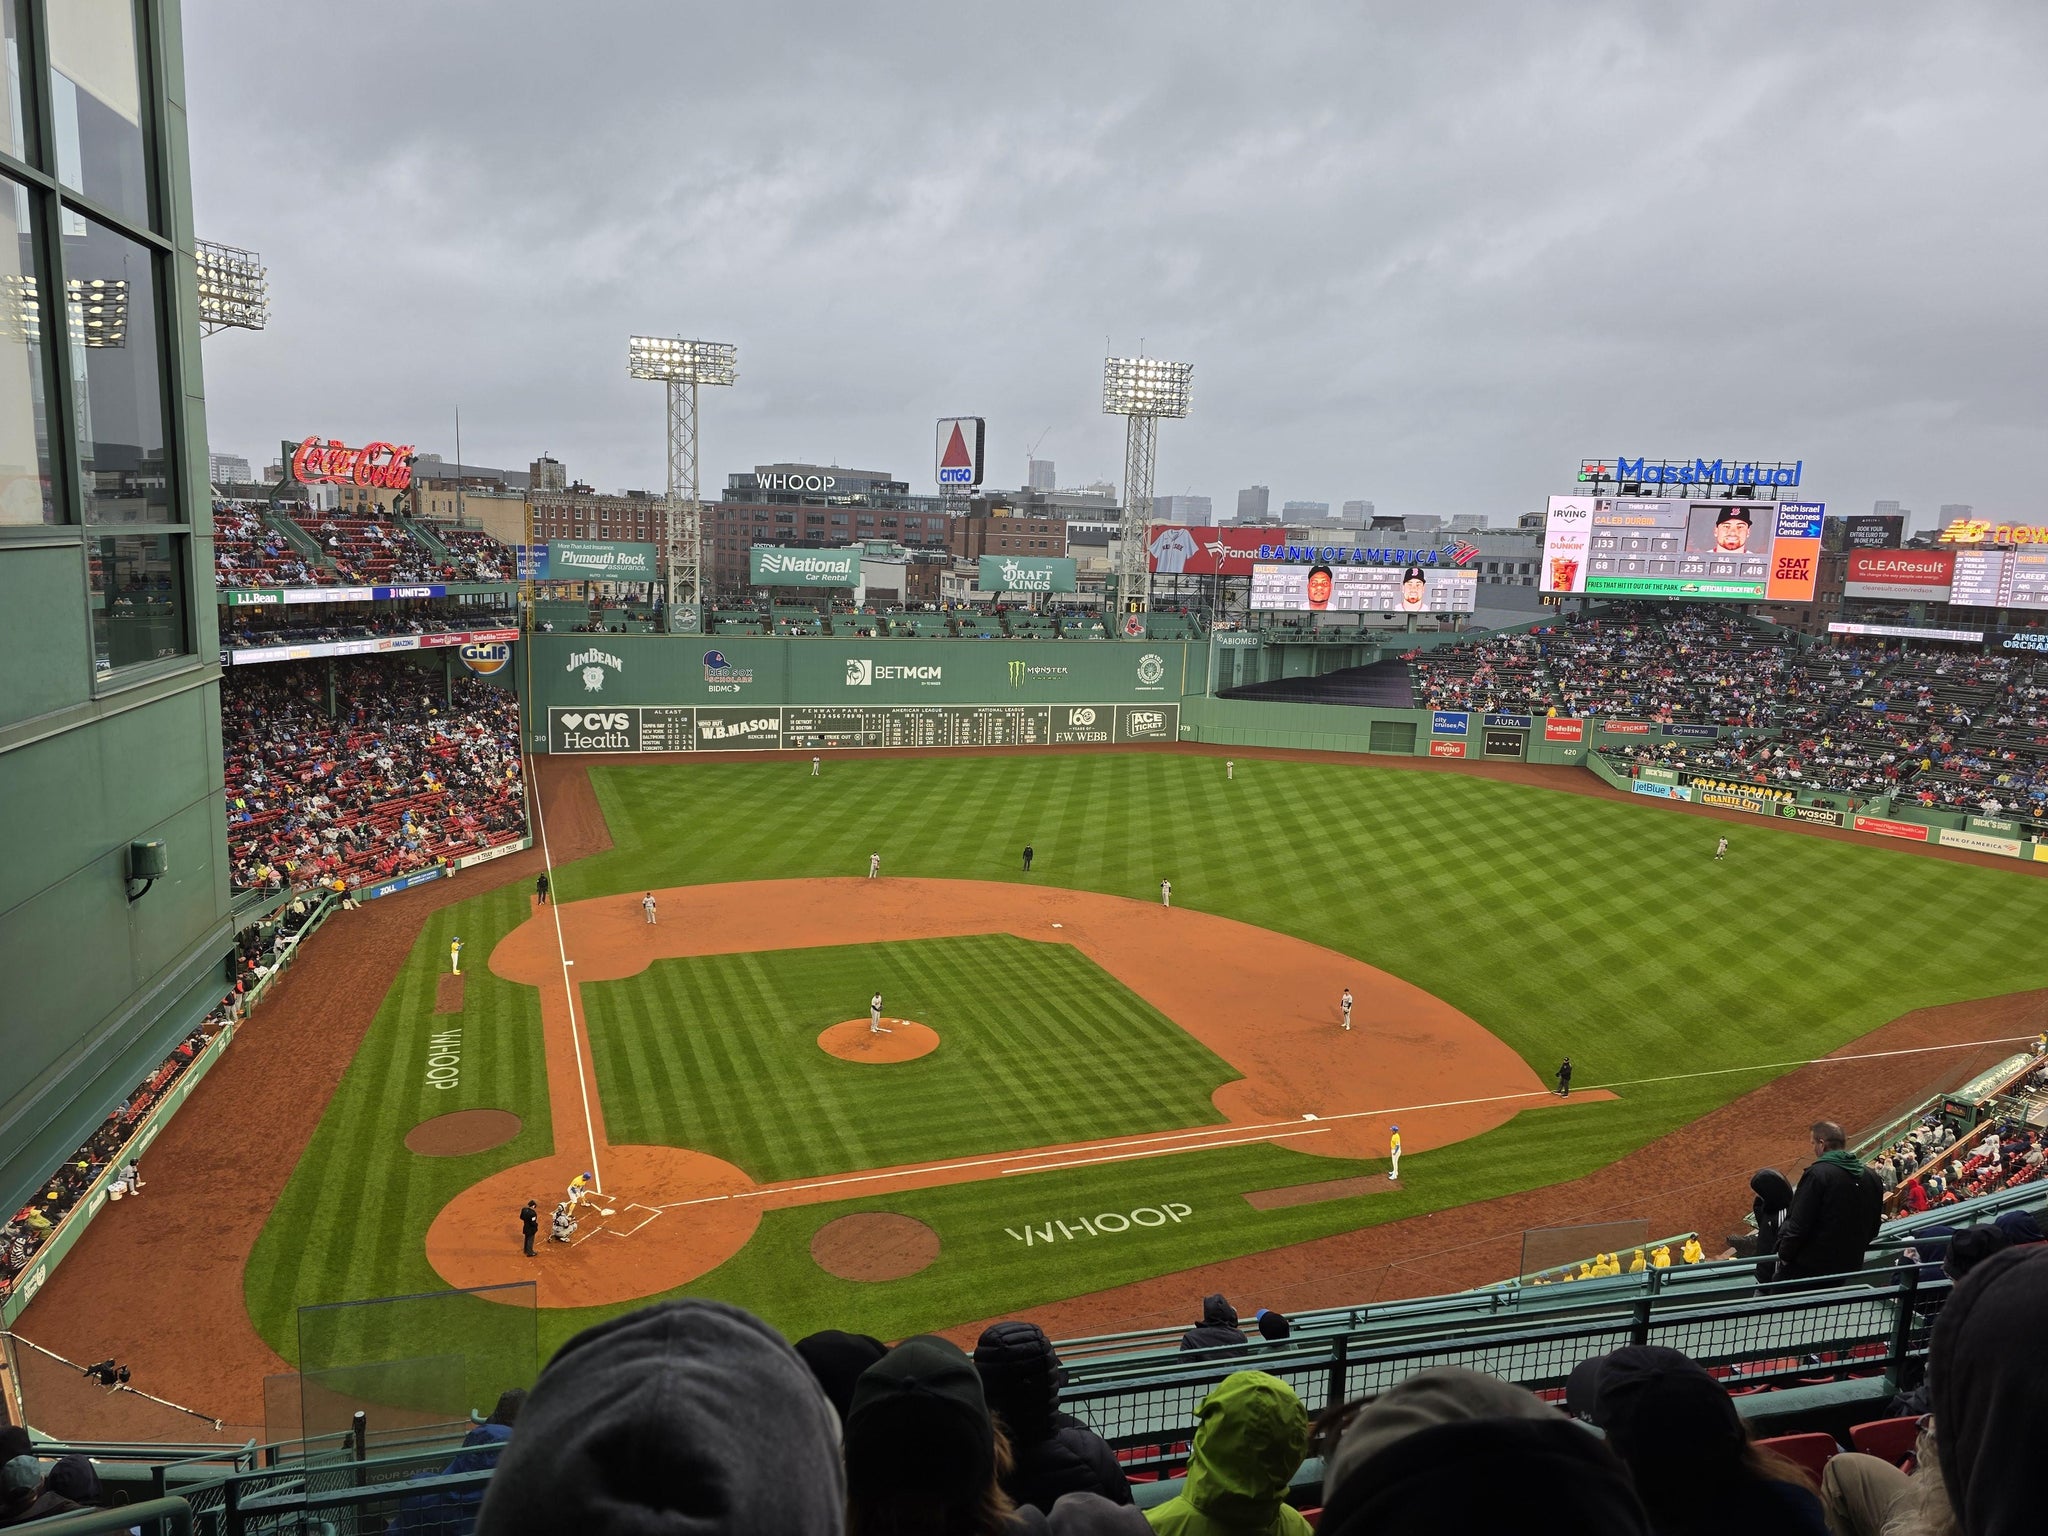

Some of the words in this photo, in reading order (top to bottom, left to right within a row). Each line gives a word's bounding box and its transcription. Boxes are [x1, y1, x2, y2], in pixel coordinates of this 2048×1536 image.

[293, 435, 415, 489] Coca-Cola
[940, 469, 971, 482] CITGO
[1615, 456, 1803, 487] MassMutual
[756, 473, 836, 492] WHOOP
[1553, 510, 1587, 518] IRVING
[1800, 505, 1820, 513] Israel
[1595, 517, 1623, 525] CALEB
[1624, 517, 1656, 525] DURBIN
[1780, 513, 1821, 521] Deaconess
[1778, 528, 1804, 536] Center
[561, 551, 614, 566] Plymouth
[617, 553, 645, 565] Rock
[1261, 545, 1316, 561] BANK
[1322, 546, 1346, 561] OF
[1352, 546, 1438, 563] AMERICA
[1779, 558, 1810, 568] SEAT
[1858, 560, 1943, 573] CLEAResult
[1680, 565, 1703, 573] .235
[1712, 566, 1733, 574] .183
[1743, 567, 1763, 575] .418
[1003, 569, 1053, 582] DRAFT
[1776, 570, 1809, 581] GEEK
[1008, 581, 1051, 590] KINGS
[1862, 585, 1933, 593] clearesult.com/redsox
[400, 588, 431, 597] UNITED
[238, 593, 277, 604] L.L.Bean
[1363, 600, 1369, 609] 2
[1383, 600, 1389, 609] 0
[1223, 637, 1258, 645] ABIOMED
[2012, 633, 2048, 642] ANGR
[462, 645, 506, 660] Gulf
[566, 653, 589, 672] JIM
[589, 648, 623, 672] BEAM
[875, 666, 942, 679] BETMGM
[1027, 666, 1068, 674] MONSTER
[583, 713, 630, 731] CVS
[1134, 712, 1163, 723] ACE
[1135, 722, 1162, 732] TICKET
[1547, 724, 1581, 733] Safelite
[564, 732, 630, 748] Health
[1077, 732, 1107, 741] WEBB
[1435, 745, 1460, 753] IRVING
[1636, 783, 1666, 795] jetBlue
[1703, 793, 1741, 806] GRANITE
[1742, 798, 1762, 811] CITY
[1798, 808, 1837, 821] wasabi
[1973, 818, 1997, 829] DICK'S
[1971, 839, 2002, 849] AMERICA
[481, 851, 493, 859] TRULY
[380, 884, 397, 896] ZOLL
[425, 1028, 462, 1090] WHOOP
[1004, 1202, 1193, 1247] WHOOP
[371, 1472, 400, 1481] YOUR
